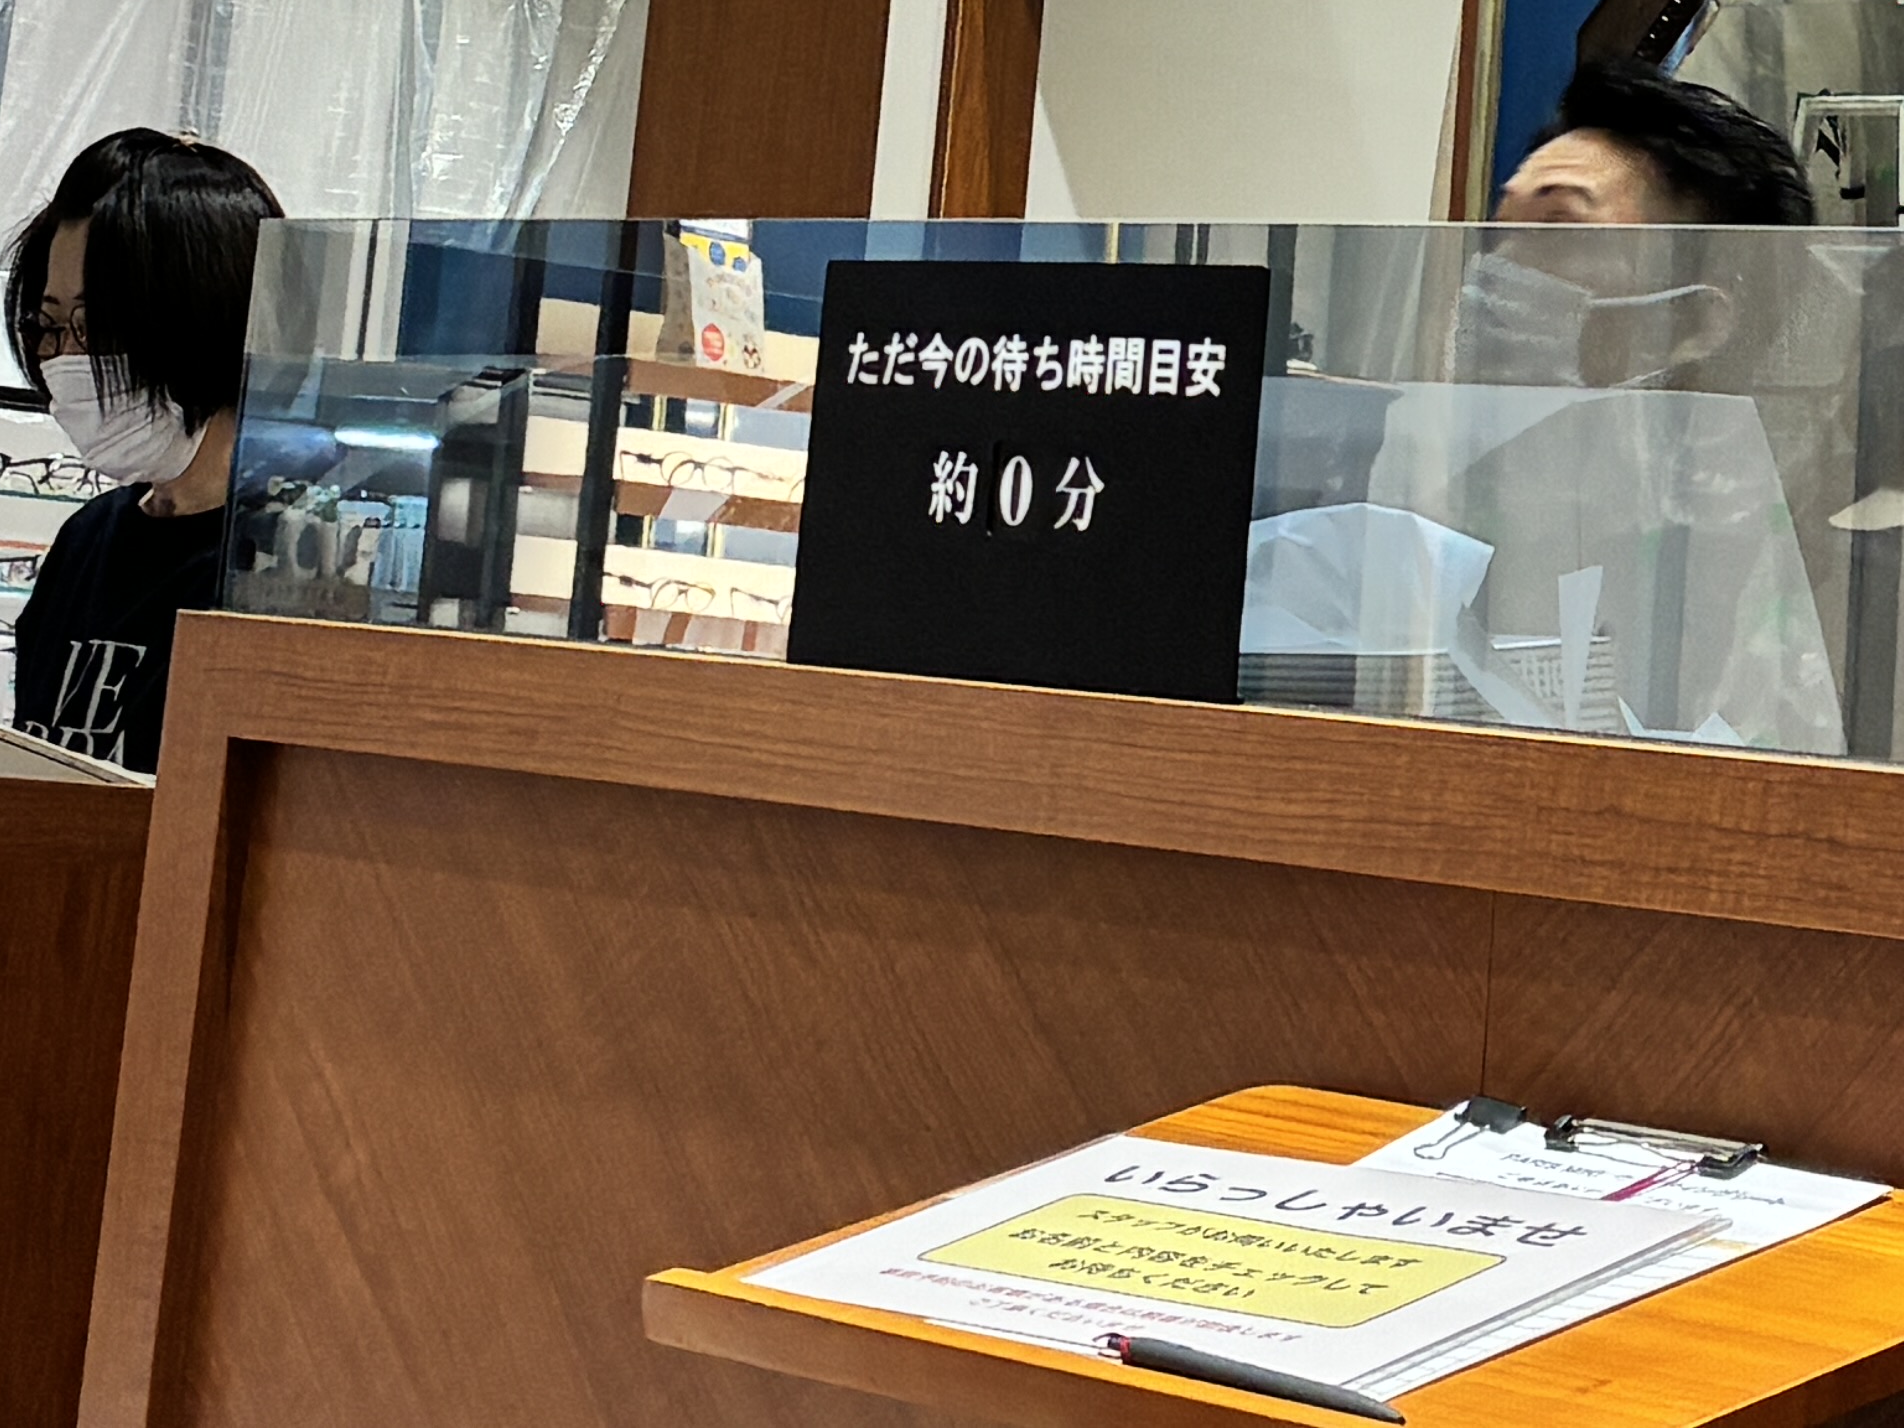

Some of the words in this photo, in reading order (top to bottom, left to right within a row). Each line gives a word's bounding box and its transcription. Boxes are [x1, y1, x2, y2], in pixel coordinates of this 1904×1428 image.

[847, 332, 1226, 397] ただ今の待ち時間目安
[52, 639, 147, 733] VE
[1103, 1164, 1589, 1247] いらっしゃいませ
[1048, 1256, 1255, 1300] お待ちください
